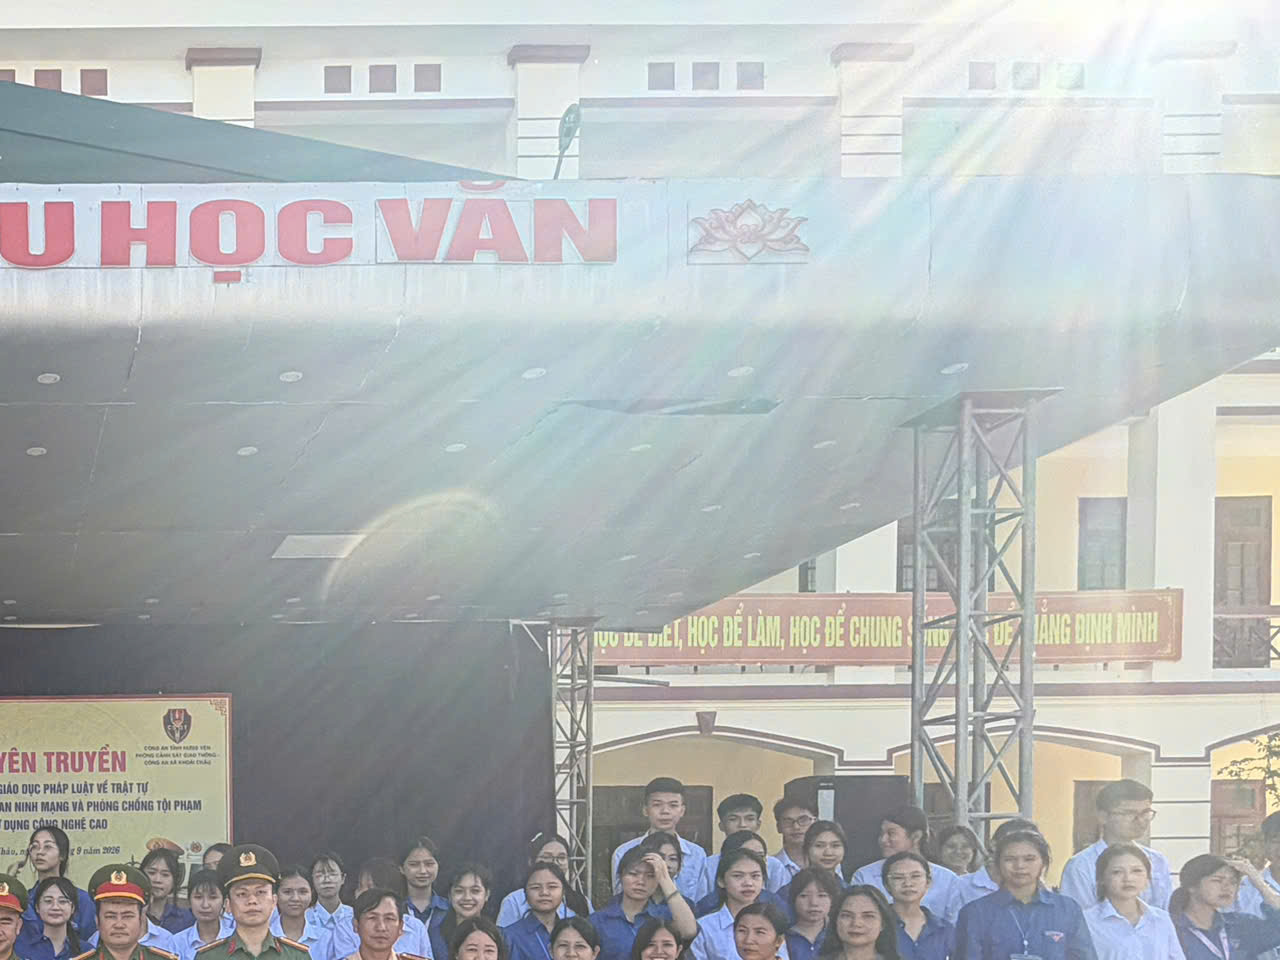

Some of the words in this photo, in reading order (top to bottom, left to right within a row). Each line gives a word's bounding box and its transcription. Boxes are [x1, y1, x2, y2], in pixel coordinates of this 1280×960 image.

[100, 198, 353, 283] HỌC
[376, 179, 617, 263] VĂN
[688, 615, 718, 655] HỌC
[723, 602, 744, 647] ĐỂ
[747, 608, 785, 650] LÀM,
[790, 615, 820, 654] HỌC
[825, 602, 846, 647] ĐỂ
[850, 615, 902, 647] CHUNG
[1117, 605, 1159, 643] MÌNH
[43, 744, 127, 773] TRUYỀN
[22, 784, 41, 797] DỤC
[43, 781, 69, 794] PHÁP
[71, 781, 94, 796] LUẬT
[111, 780, 133, 796] TRẬT
[135, 781, 149, 795] TỰ
[14, 802, 38, 812] NINH
[41, 801, 69, 815] MẠNG
[72, 800, 84, 812] VÀ
[86, 799, 119, 812] PHÒNG
[121, 797, 154, 812] CHỐNG
[156, 798, 171, 812] TỘI
[174, 799, 202, 813] PHẠM
[4, 820, 29, 833] DỤNG
[61, 818, 87, 832] NGHỆ
[89, 819, 108, 830] CAO
[76, 847, 83, 856] 9
[83, 847, 101, 856] năm
